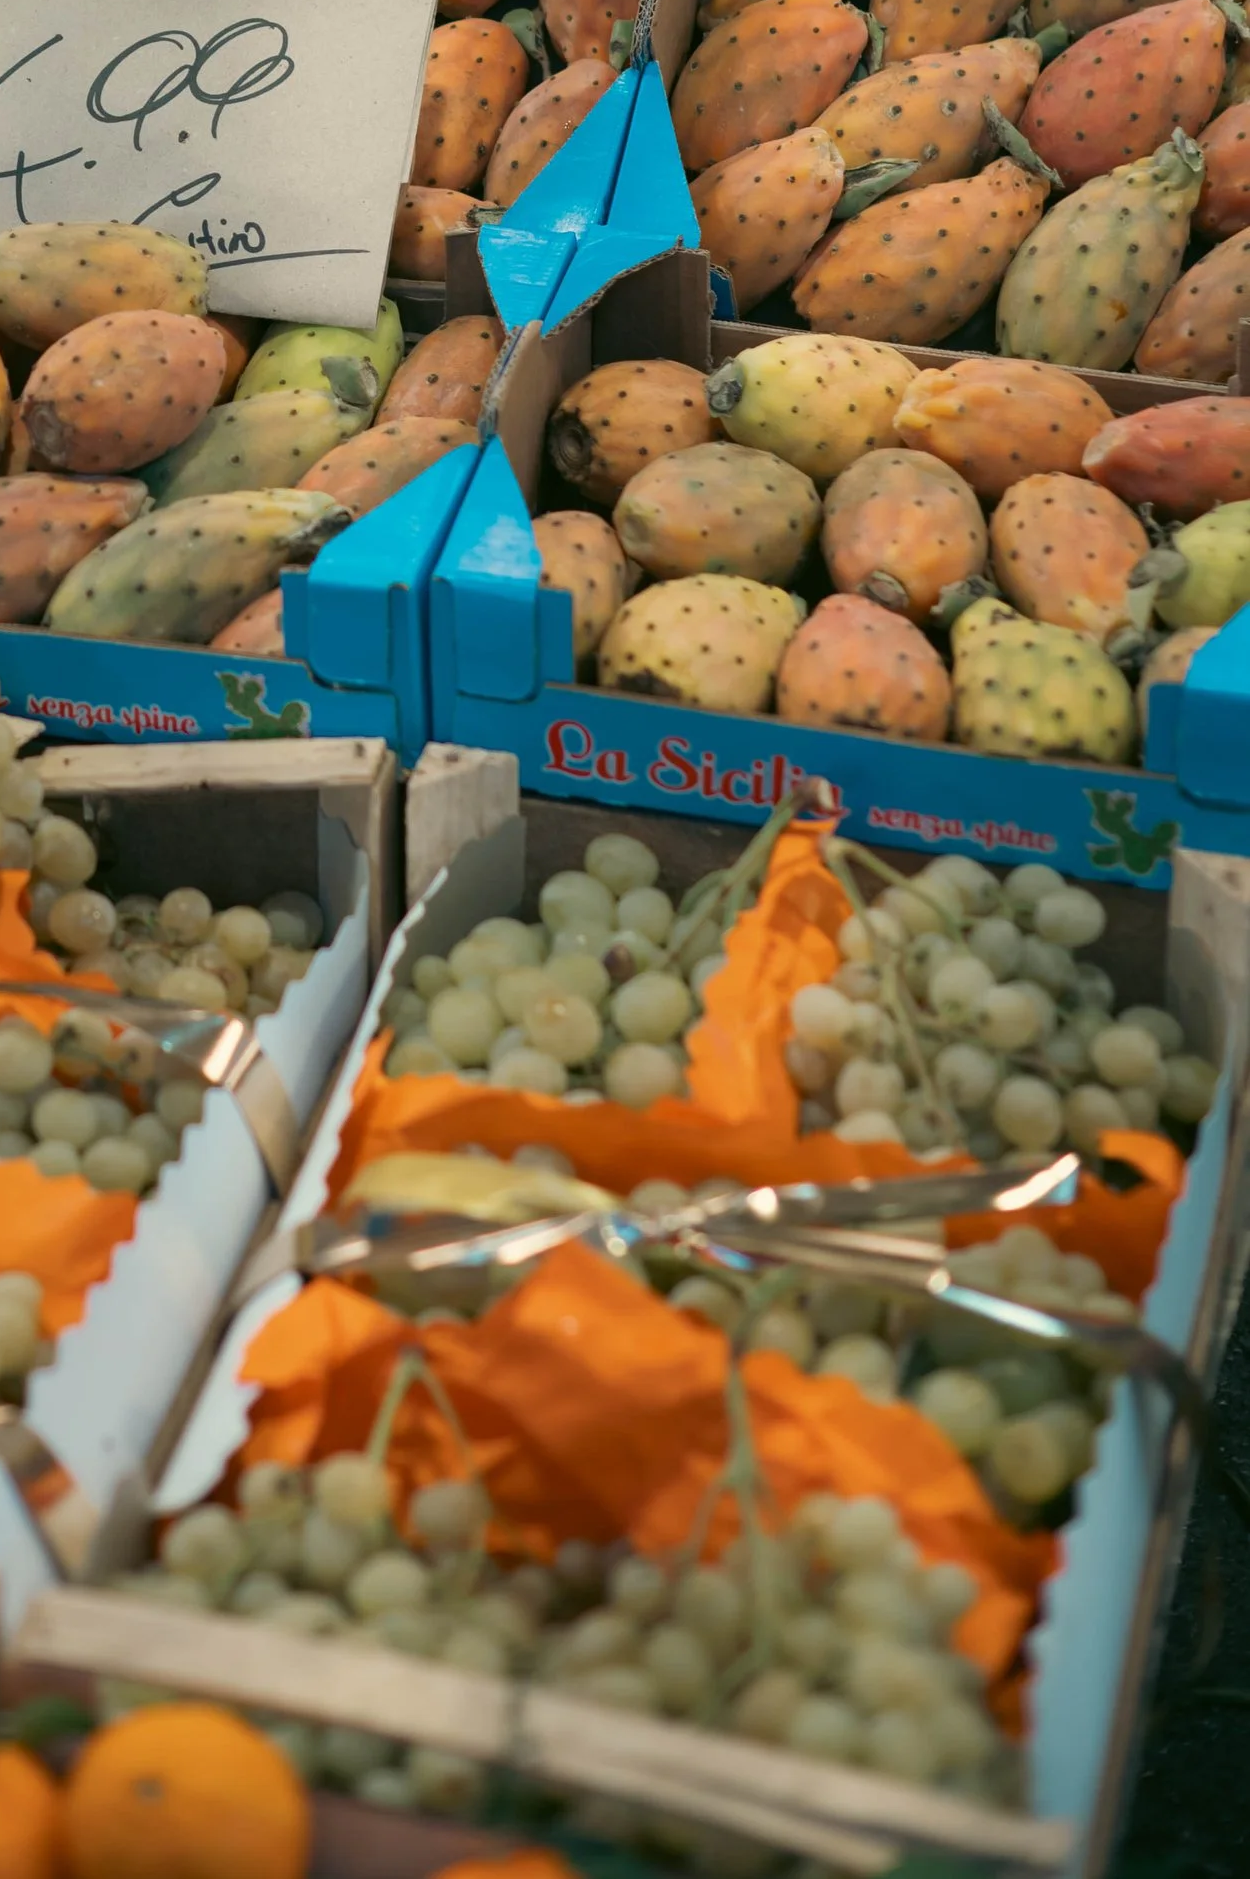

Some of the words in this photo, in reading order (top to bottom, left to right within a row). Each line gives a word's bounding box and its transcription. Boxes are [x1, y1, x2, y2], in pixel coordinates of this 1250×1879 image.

[27, 694, 116, 729] senza
[119, 704, 202, 736] spine
[544, 719, 634, 784] La
[869, 806, 966, 843] senza
